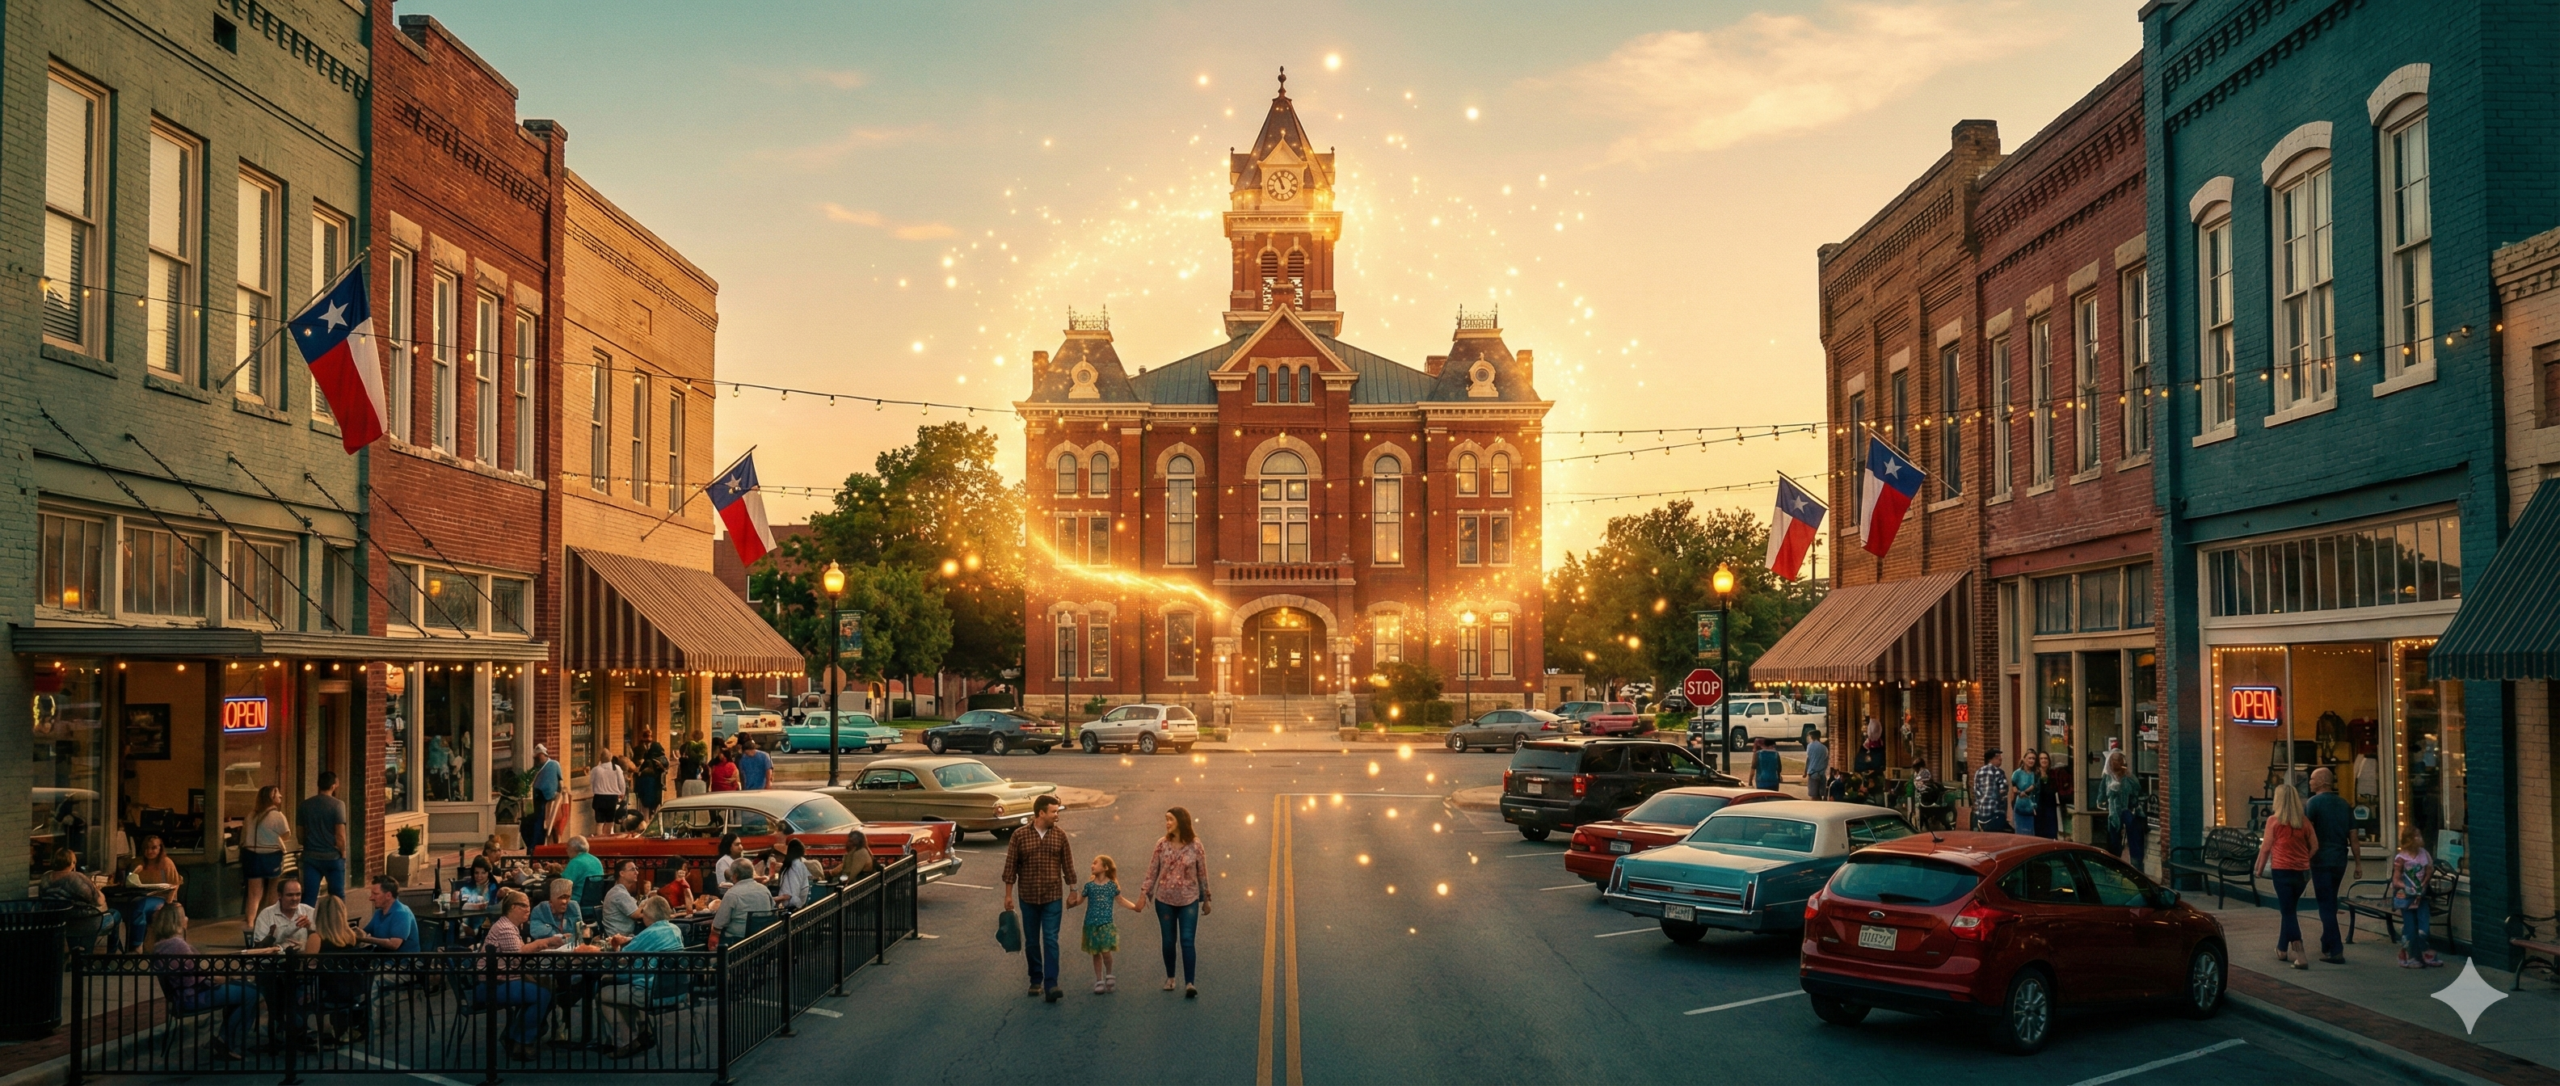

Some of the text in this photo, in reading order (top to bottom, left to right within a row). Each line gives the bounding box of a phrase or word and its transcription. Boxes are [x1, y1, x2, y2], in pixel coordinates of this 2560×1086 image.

[1687, 681, 1720, 695] STOP
[225, 701, 265, 728] OPEN
[2232, 690, 2275, 719] OPEN
